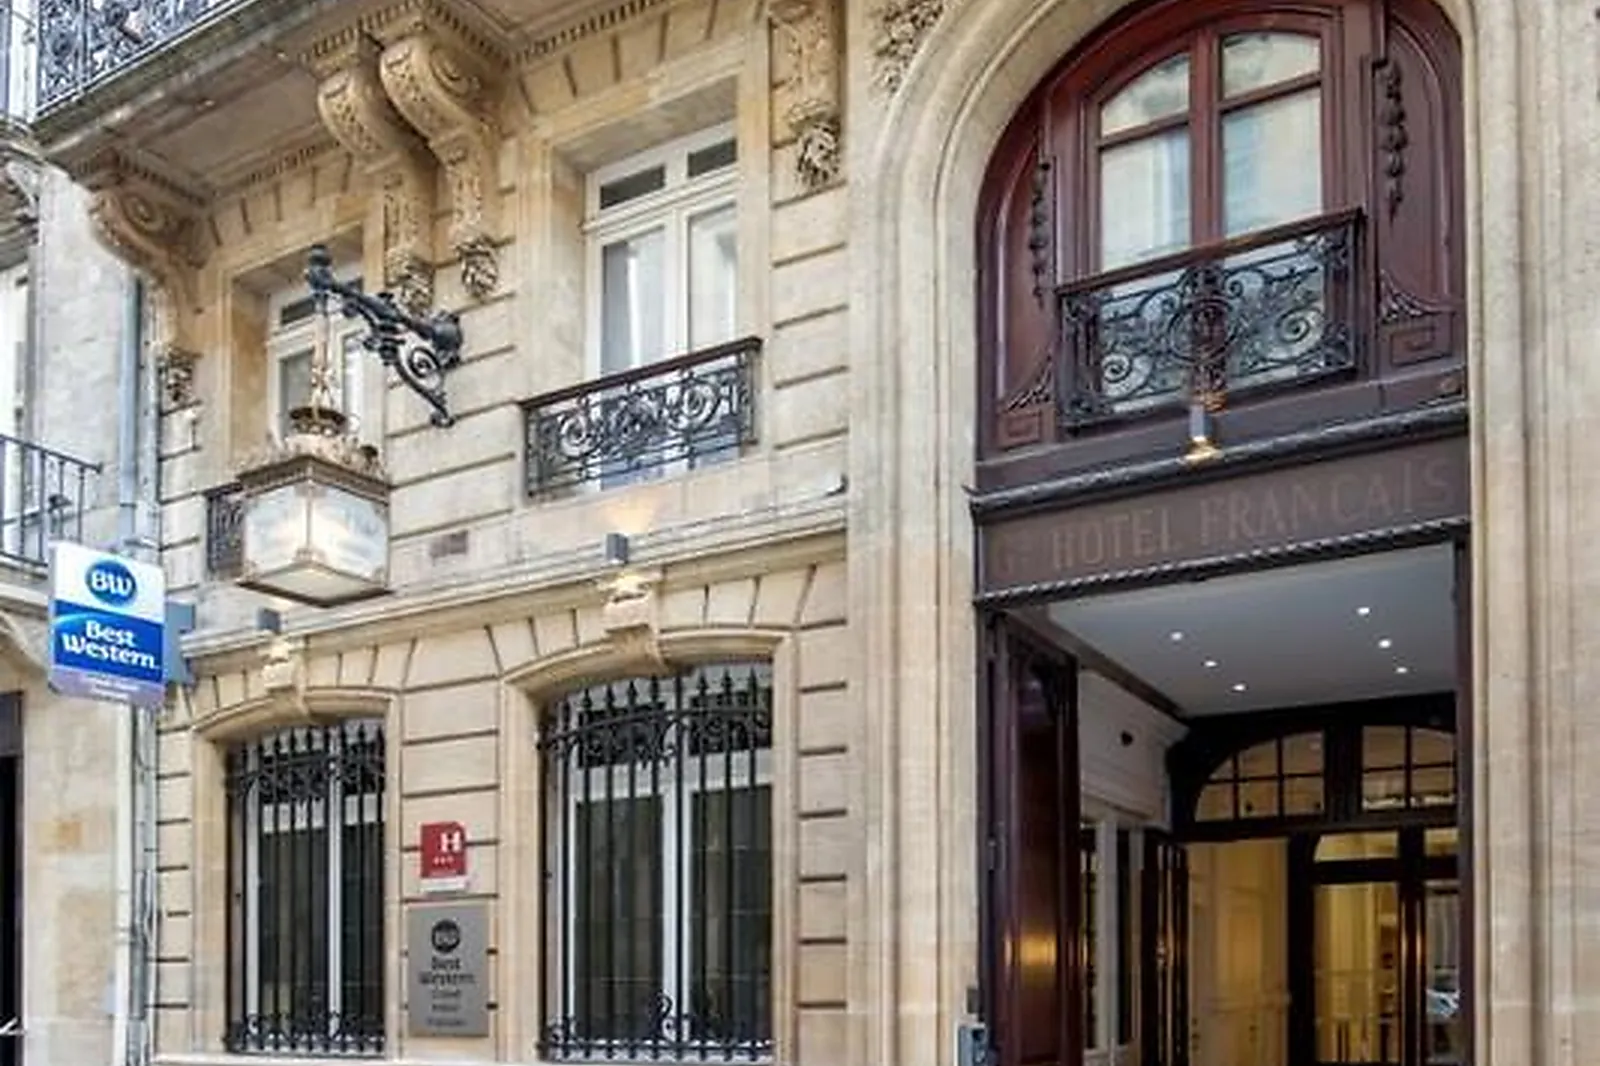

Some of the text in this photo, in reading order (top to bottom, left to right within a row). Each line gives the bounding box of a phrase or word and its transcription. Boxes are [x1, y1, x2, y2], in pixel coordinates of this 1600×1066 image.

[1051, 506, 1173, 571] HOTEL
[91, 569, 133, 597] BW
[85, 619, 137, 648] Best
[61, 632, 157, 670] Western
[440, 831, 461, 853] H
